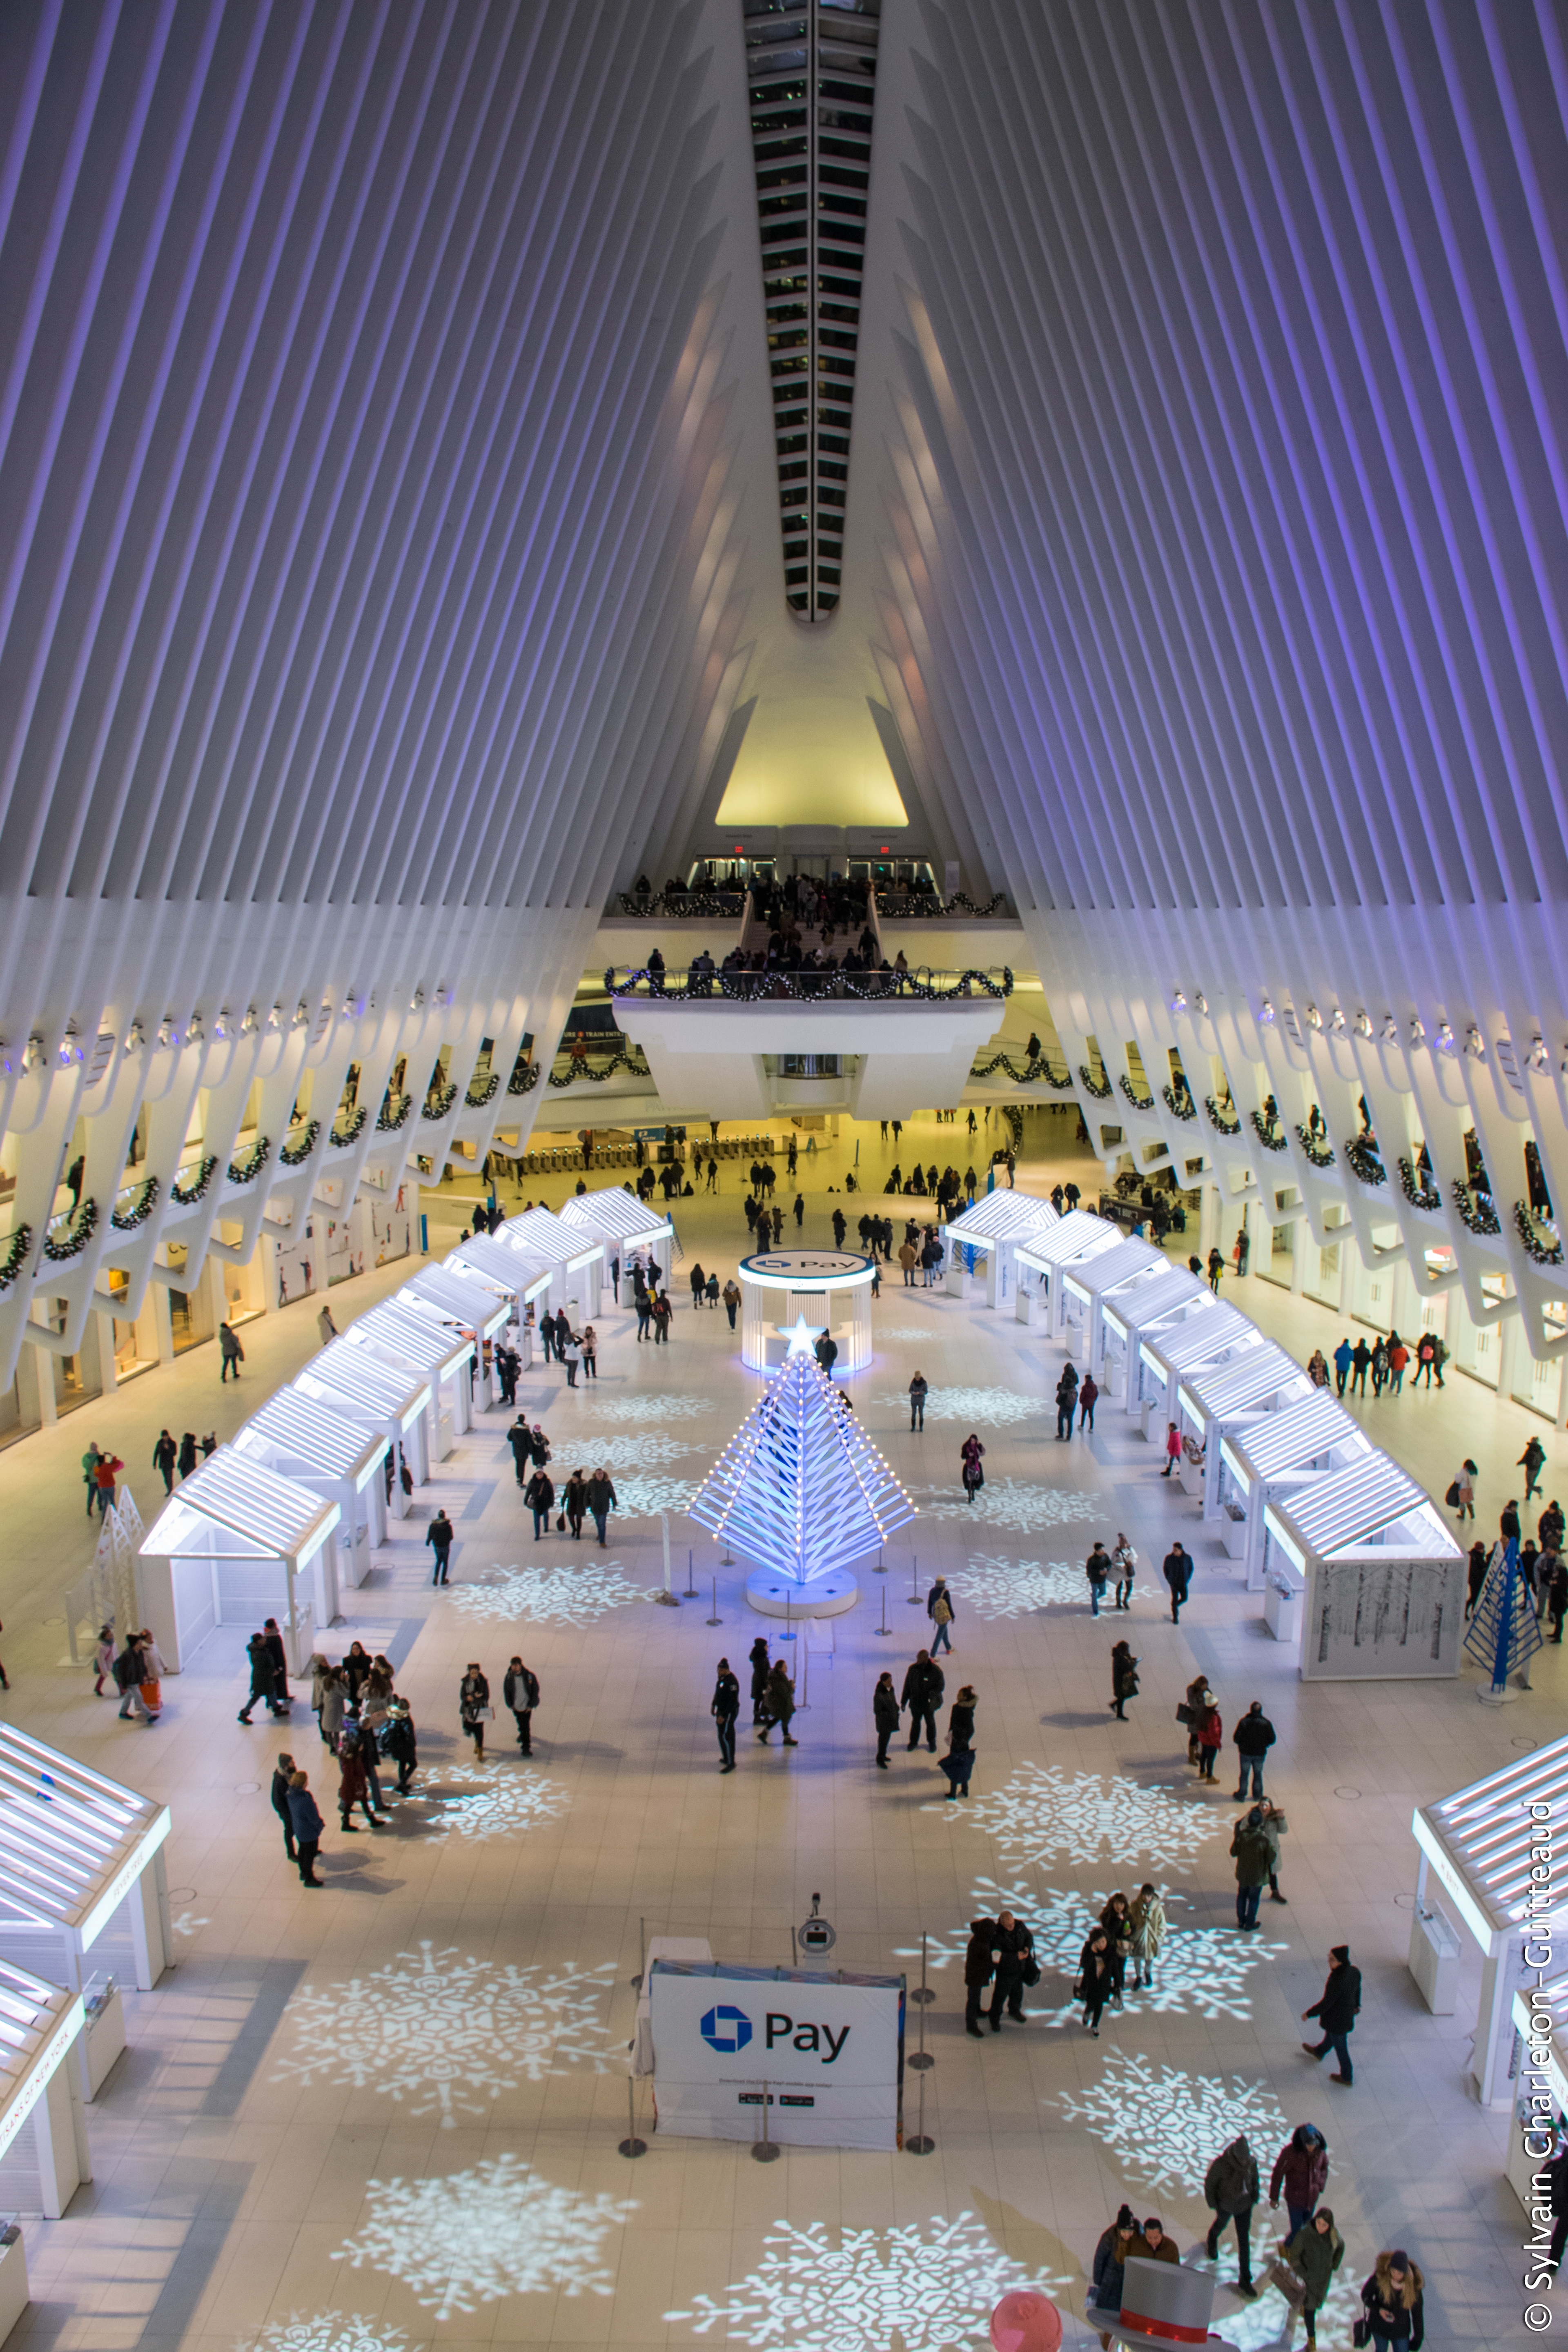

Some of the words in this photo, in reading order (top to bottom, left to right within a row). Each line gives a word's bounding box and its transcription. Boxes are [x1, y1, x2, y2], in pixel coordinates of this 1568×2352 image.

[766, 2013, 851, 2064] Pay
[0, 2102, 23, 2144] TISANS
[25, 2084, 34, 2104] OF
[36, 2058, 50, 2087] NEW
[51, 2028, 68, 2060] YORK
